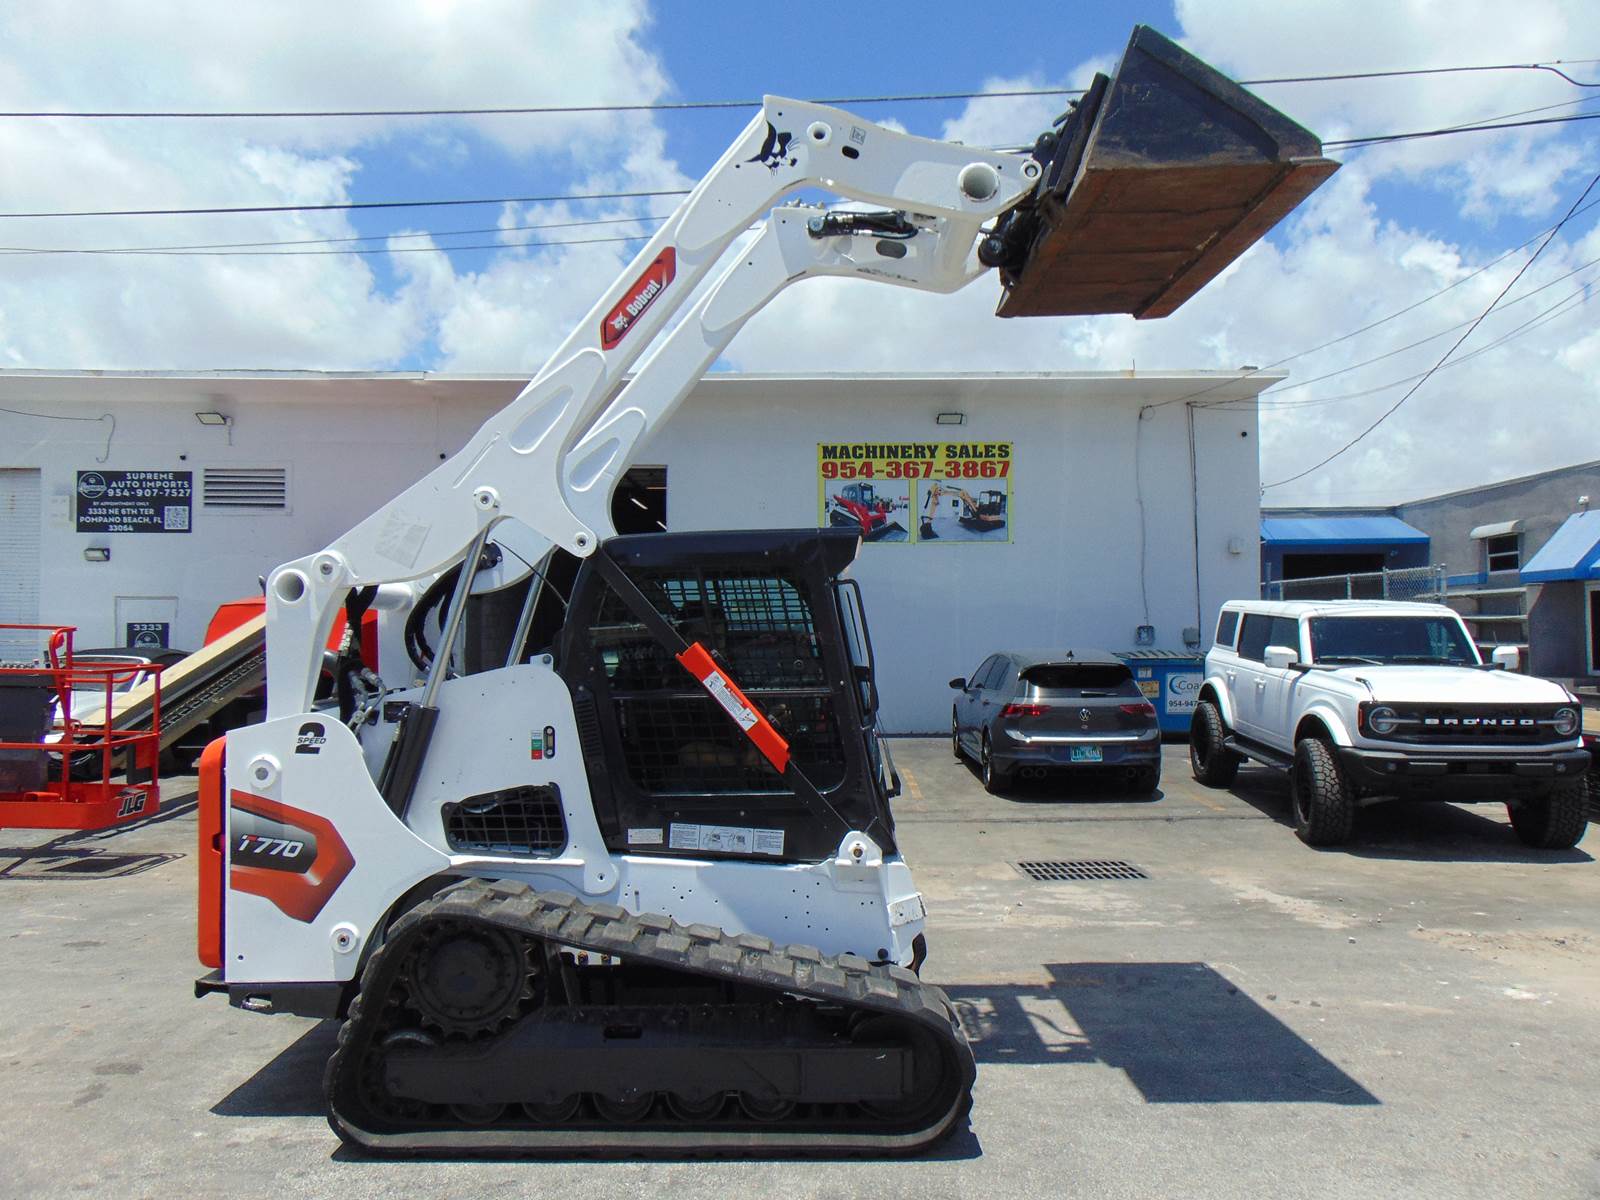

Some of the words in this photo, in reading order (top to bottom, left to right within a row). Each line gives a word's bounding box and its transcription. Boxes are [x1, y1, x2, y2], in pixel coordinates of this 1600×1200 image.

[626, 279, 661, 316] Bobcat
[822, 444, 939, 459] MACHINERY
[945, 444, 1010, 459] SALES
[821, 460, 1010, 479] 954-367-3867
[126, 472, 174, 480] SUPREME
[107, 488, 191, 497] 954-907-7527
[1424, 718, 1535, 726] BRONCO
[297, 736, 327, 744] SPEED
[117, 792, 147, 817] JLG
